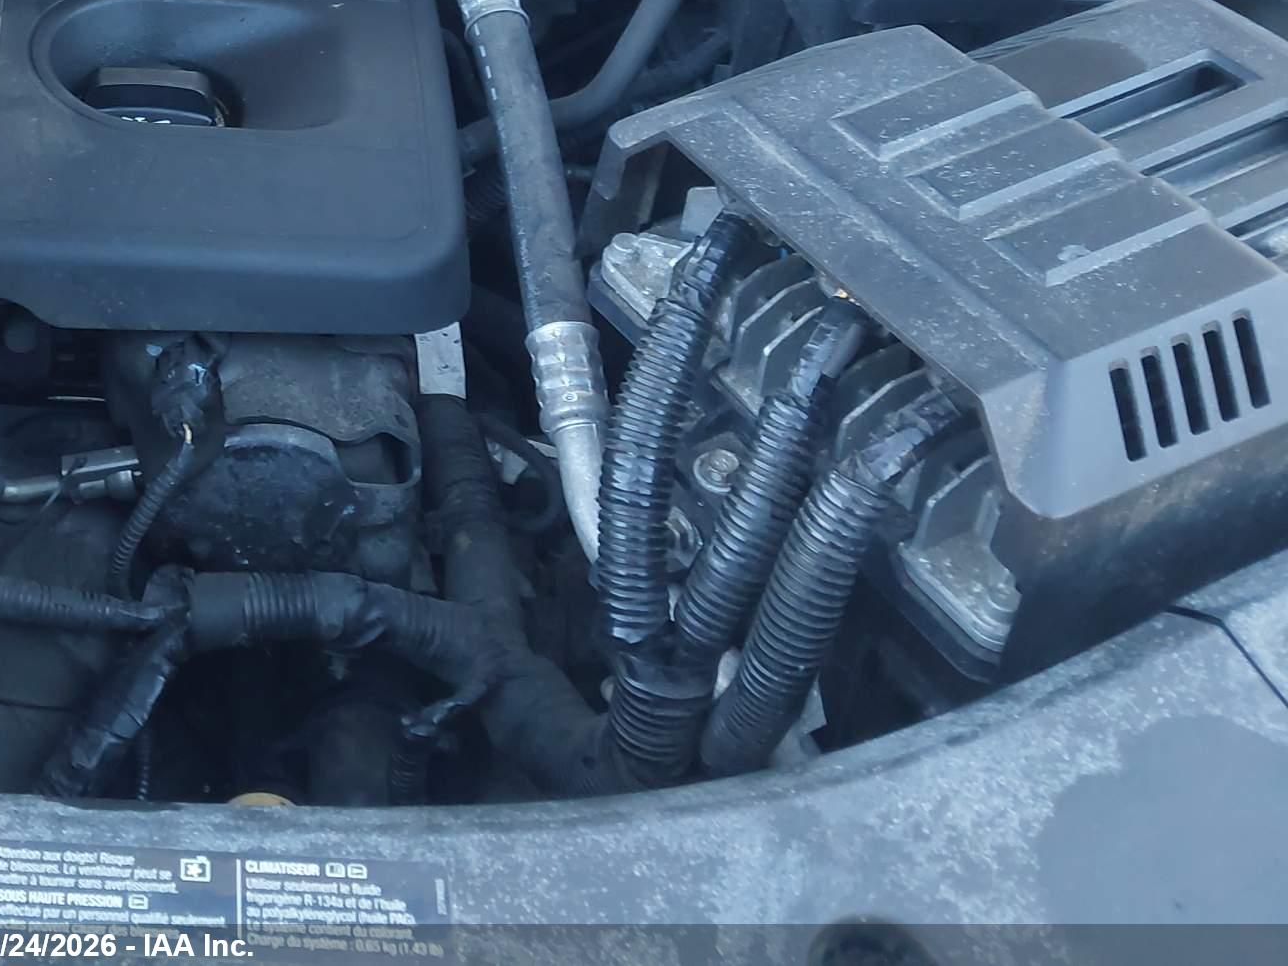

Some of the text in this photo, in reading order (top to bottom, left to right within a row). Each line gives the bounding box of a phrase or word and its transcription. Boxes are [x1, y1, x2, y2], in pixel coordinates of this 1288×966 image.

[42, 850, 61, 861] aux
[62, 850, 98, 865] doigts!
[99, 851, 135, 867] Risque
[9, 860, 60, 874] blessures.
[62, 862, 76, 874] Le
[77, 864, 132, 878] ventilateur
[133, 866, 158, 880] peut
[158, 869, 172, 880] se
[244, 859, 320, 876] CLIMATISEUR
[38, 874, 75, 887] tourner
[76, 877, 102, 889] sans
[245, 877, 382, 896] Utiliser seulement le fluide
[27, 890, 66, 905] HAUTE
[66, 892, 122, 908] PRESSION
[303, 892, 344, 908] R-134a
[344, 896, 356, 908] et
[358, 896, 372, 909] de
[42, 907, 60, 920] par
[62, 908, 76, 919] un
[77, 908, 130, 923] personnel
[245, 906, 260, 917] au
[246, 918, 260, 931] Le
[262, 919, 306, 935] système
[307, 922, 351, 936] contient
[352, 924, 367, 937] du
[246, 932, 284, 948] Charge
[286, 935, 301, 947] du
[302, 935, 348, 952] système
[382, 940, 397, 955] kg
